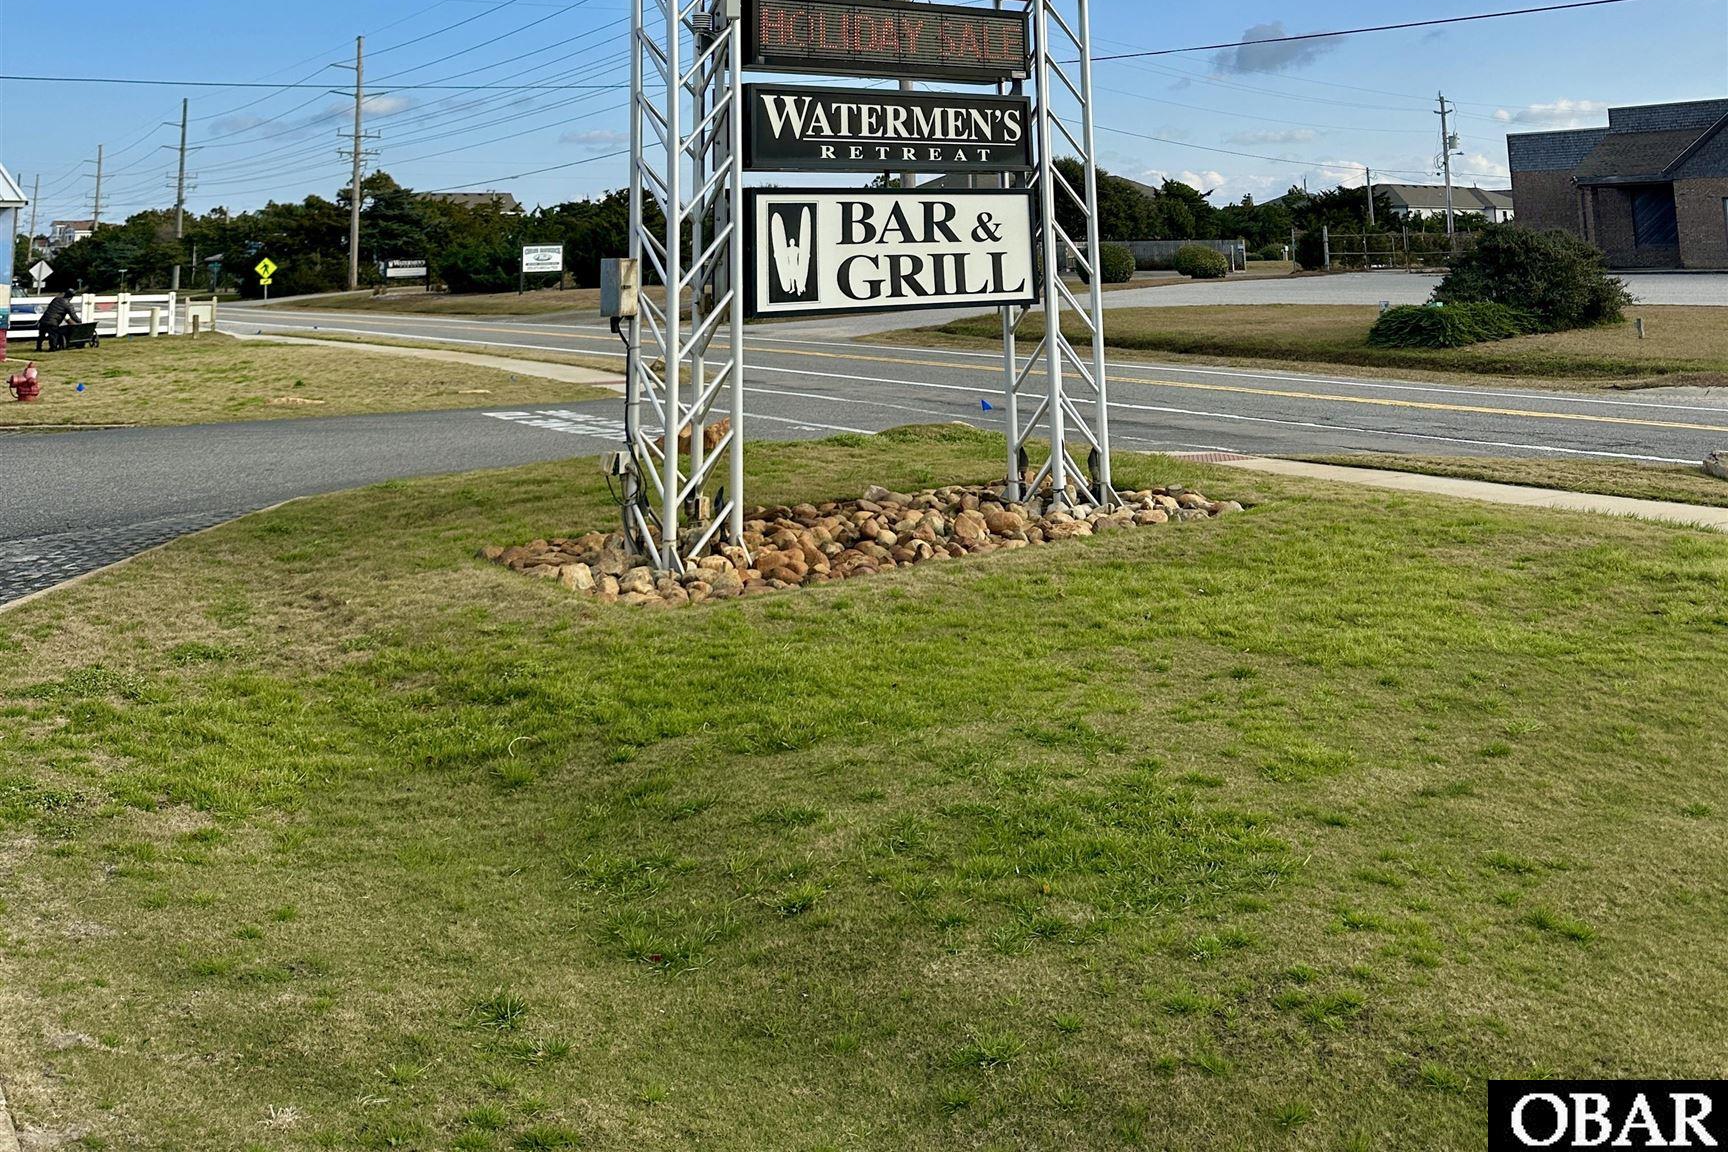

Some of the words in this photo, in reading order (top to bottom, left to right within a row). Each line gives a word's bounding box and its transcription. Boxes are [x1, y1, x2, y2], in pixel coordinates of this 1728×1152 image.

[759, 8, 924, 54] HOLIDAY
[940, 20, 1022, 60] SALE
[760, 94, 1022, 142] WATERMEN'S
[819, 145, 991, 162] RETREAT
[836, 200, 962, 245] BAR
[970, 211, 1003, 242] &
[836, 252, 1026, 301] GRILL
